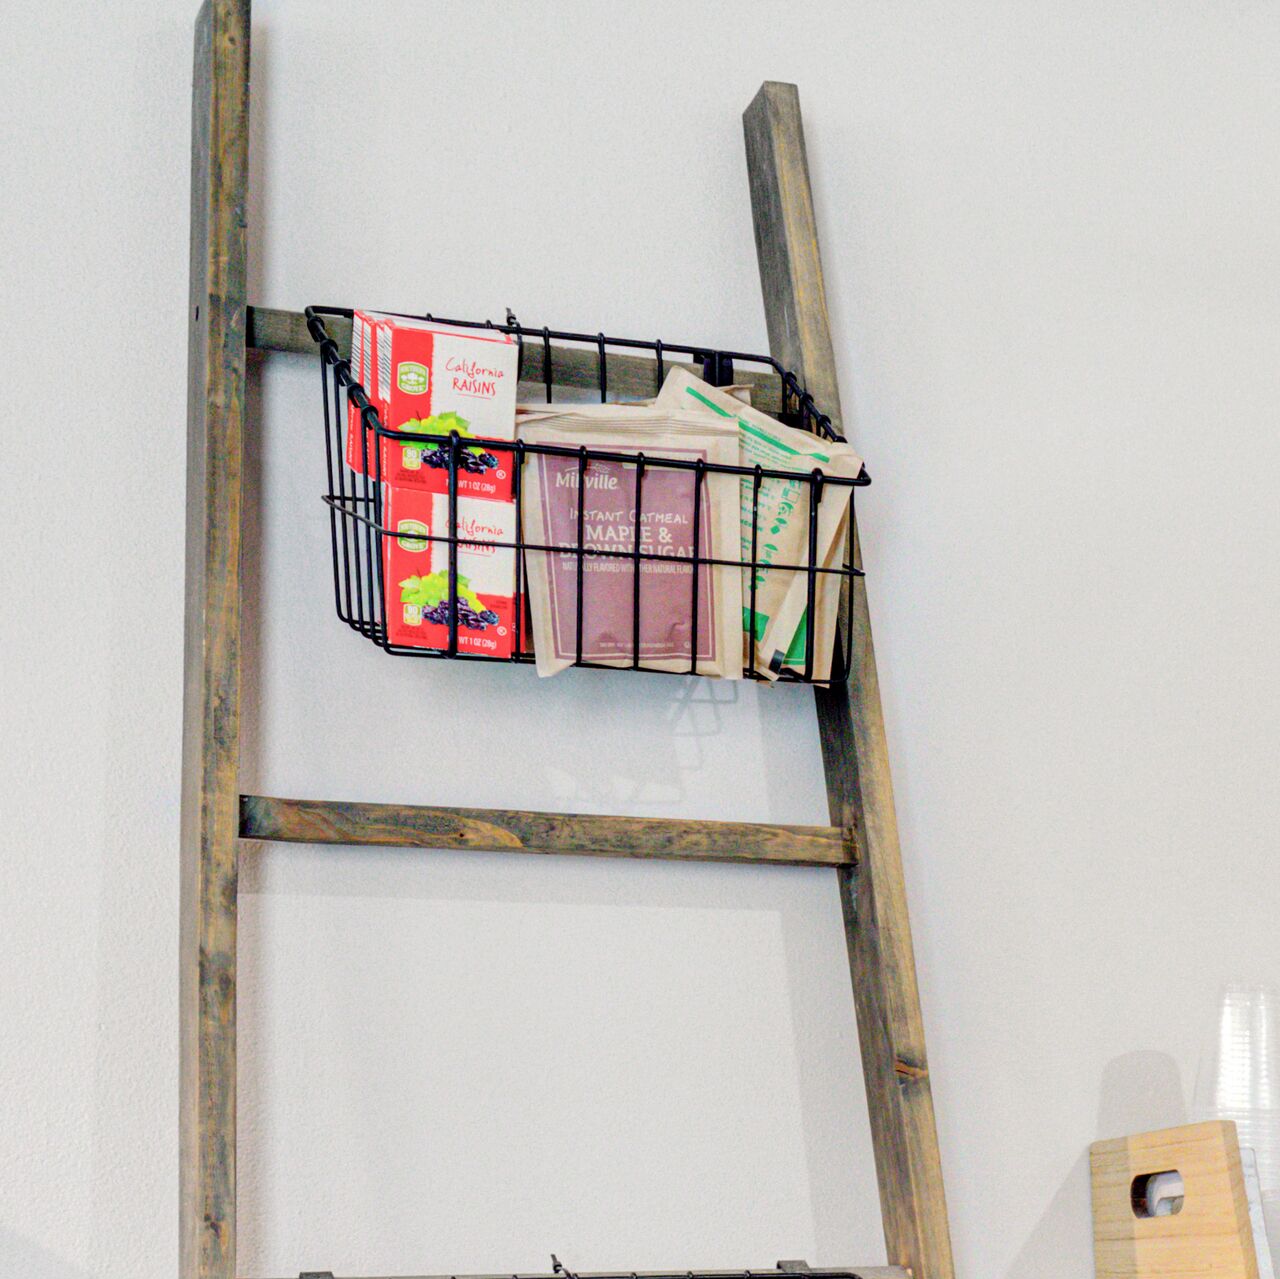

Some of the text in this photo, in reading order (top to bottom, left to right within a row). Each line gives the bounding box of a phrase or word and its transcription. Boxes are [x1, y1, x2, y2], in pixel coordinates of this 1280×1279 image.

[445, 357, 505, 379] California
[452, 377, 497, 397] RAISINS
[556, 472, 618, 490] Milville
[570, 508, 689, 525] INSTANT OATMEAL
[585, 524, 673, 544] MAPLE &
